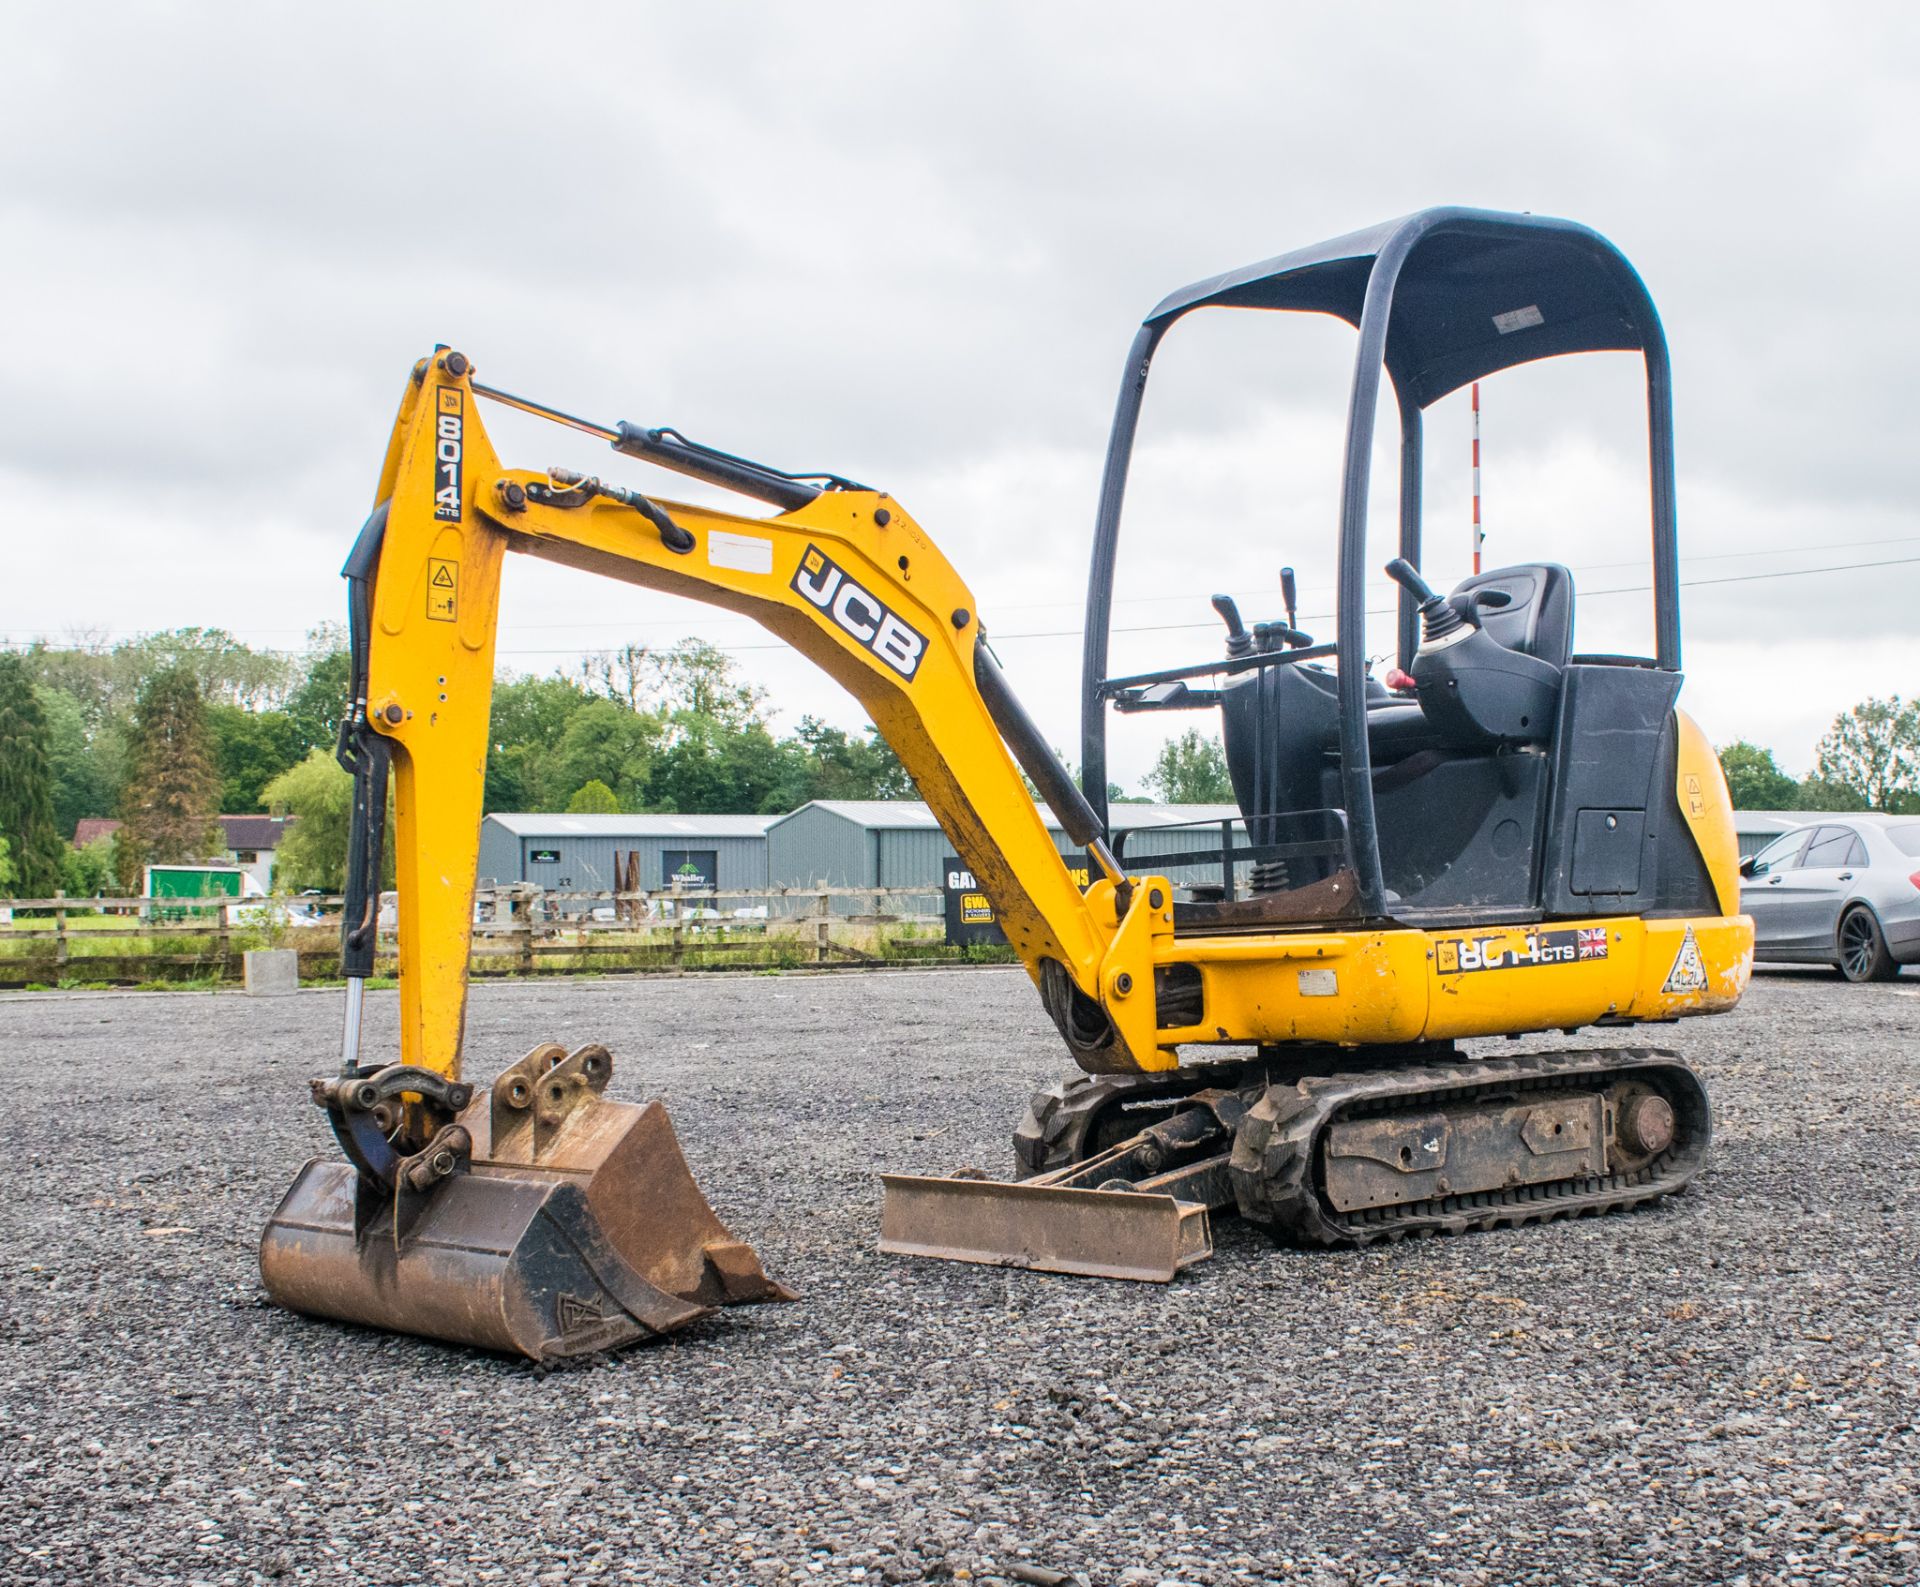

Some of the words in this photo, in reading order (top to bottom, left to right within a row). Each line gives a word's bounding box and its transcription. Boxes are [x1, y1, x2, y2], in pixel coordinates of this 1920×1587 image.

[438, 416, 461, 509] 8014
[437, 508, 459, 517] CTS
[797, 567, 922, 675] JCB
[671, 874, 705, 883] Whalley
[964, 896, 990, 908] GWA
[1541, 945, 1575, 961] CTS
[1683, 952, 1695, 966] 45
